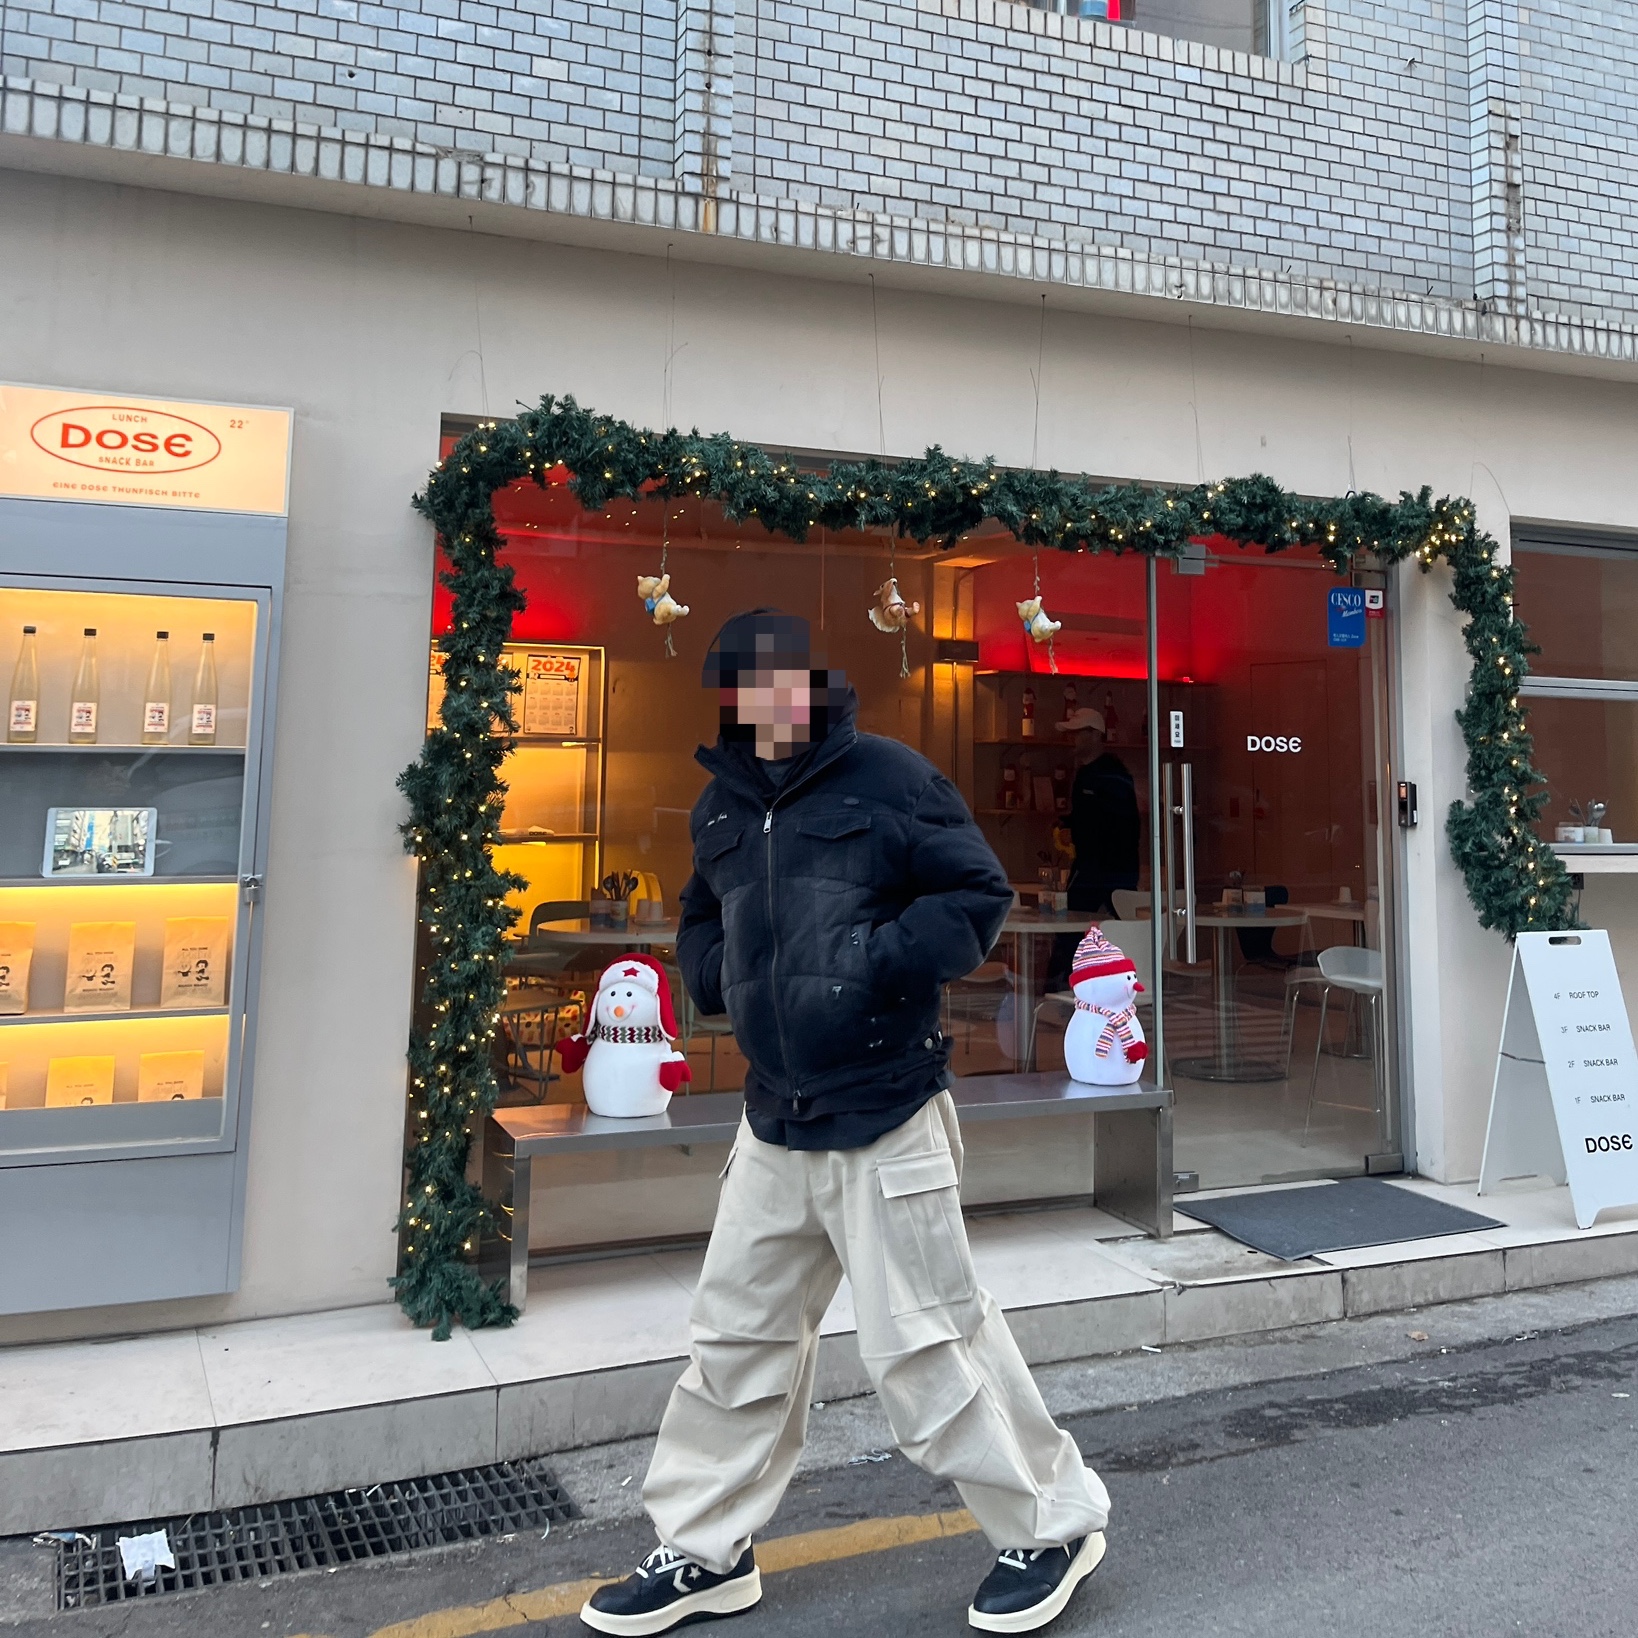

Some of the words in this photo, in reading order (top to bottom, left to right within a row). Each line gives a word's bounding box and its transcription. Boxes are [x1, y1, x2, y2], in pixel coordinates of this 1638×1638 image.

[111, 413, 148, 423] LUNCH
[98, 456, 131, 466] SNACK
[135, 459, 155, 467] BAR
[112, 486, 168, 497] THUNFISCH
[1331, 593, 1361, 607] CESCO
[531, 659, 576, 673] 2024
[1553, 992, 1561, 1000] 4F
[1568, 991, 1586, 999] ROOF
[1586, 990, 1599, 999] TOP
[1560, 1025, 1568, 1034] 3F
[1576, 1025, 1597, 1033] SNACK
[1598, 1024, 1611, 1032] BAR
[1567, 1060, 1575, 1069] 2F
[1583, 1059, 1605, 1068] SNACK
[1605, 1058, 1618, 1066] BAR
[1574, 1096, 1581, 1104] 1F
[1590, 1094, 1612, 1104] SNACK
[1612, 1093, 1625, 1102] BAR
